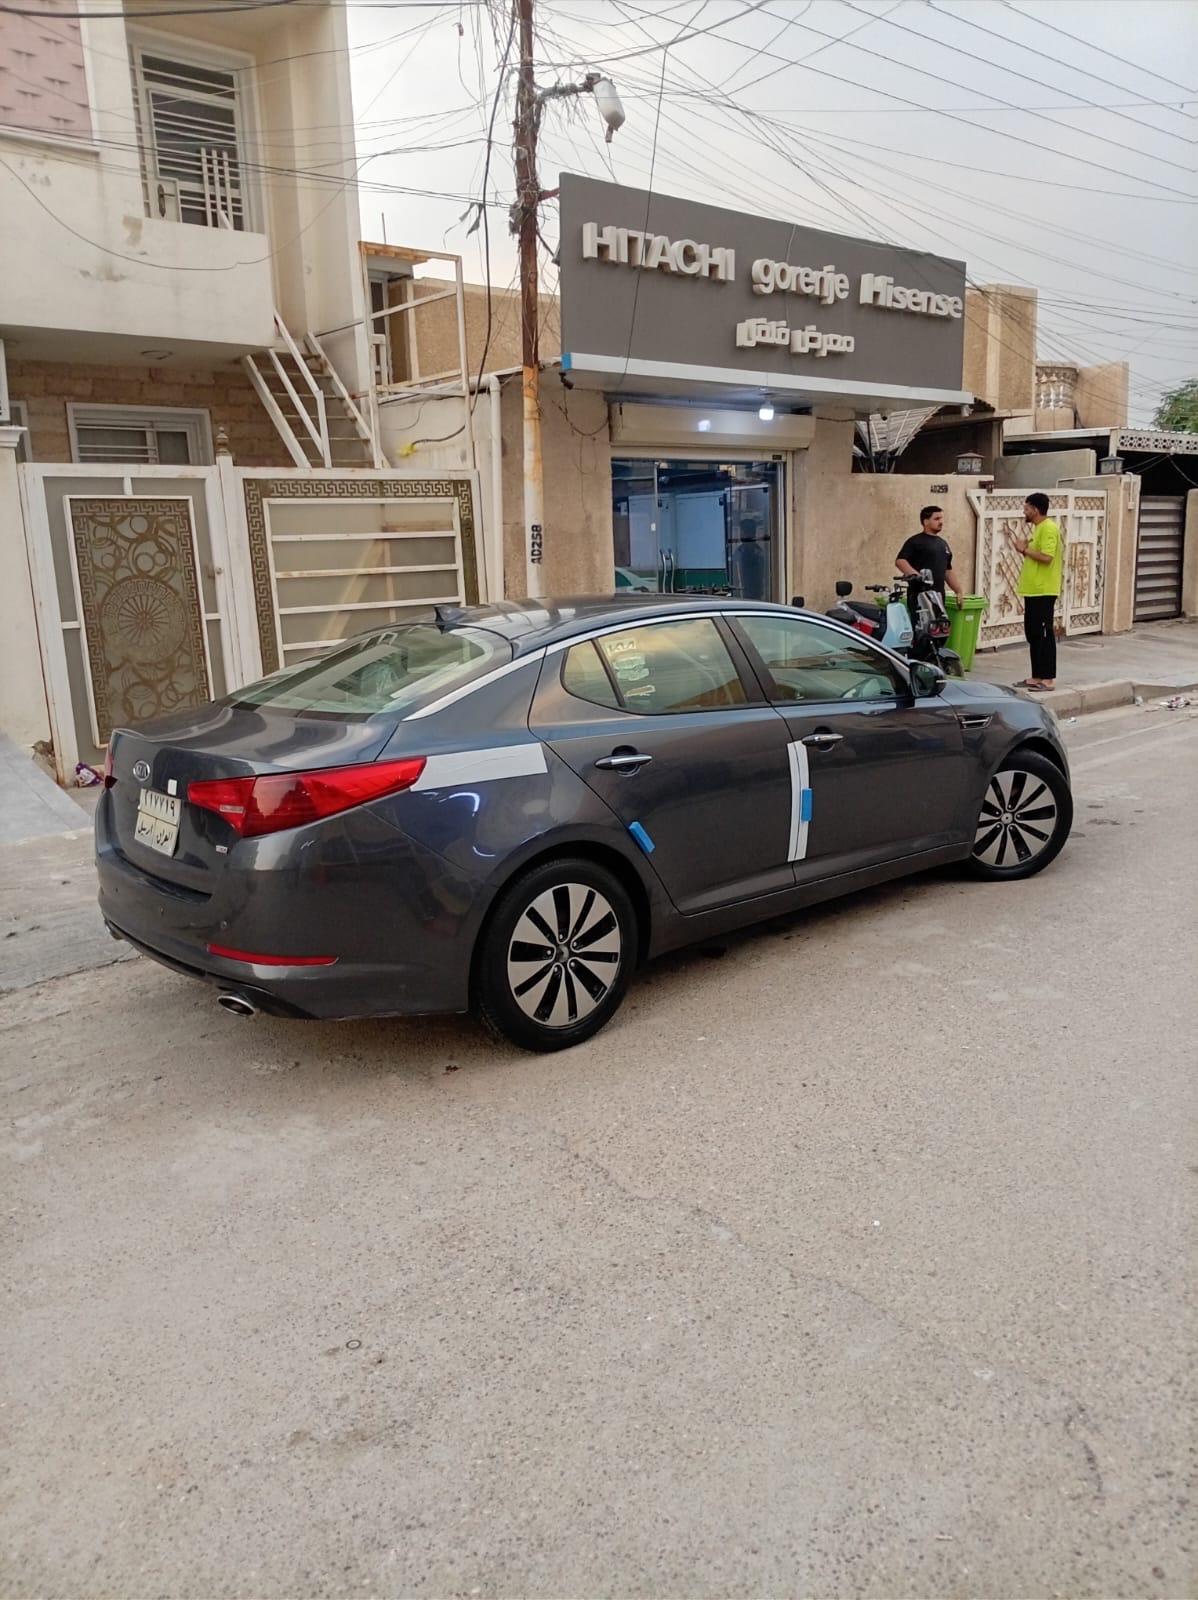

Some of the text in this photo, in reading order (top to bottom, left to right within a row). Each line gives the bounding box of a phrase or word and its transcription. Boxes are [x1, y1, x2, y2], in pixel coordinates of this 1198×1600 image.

[583, 221, 735, 281] HITACHI
[752, 258, 849, 304] gorenje
[860, 272, 963, 318] Hisense
[790, 324, 855, 357] معرض
[531, 524, 542, 565] AD258
